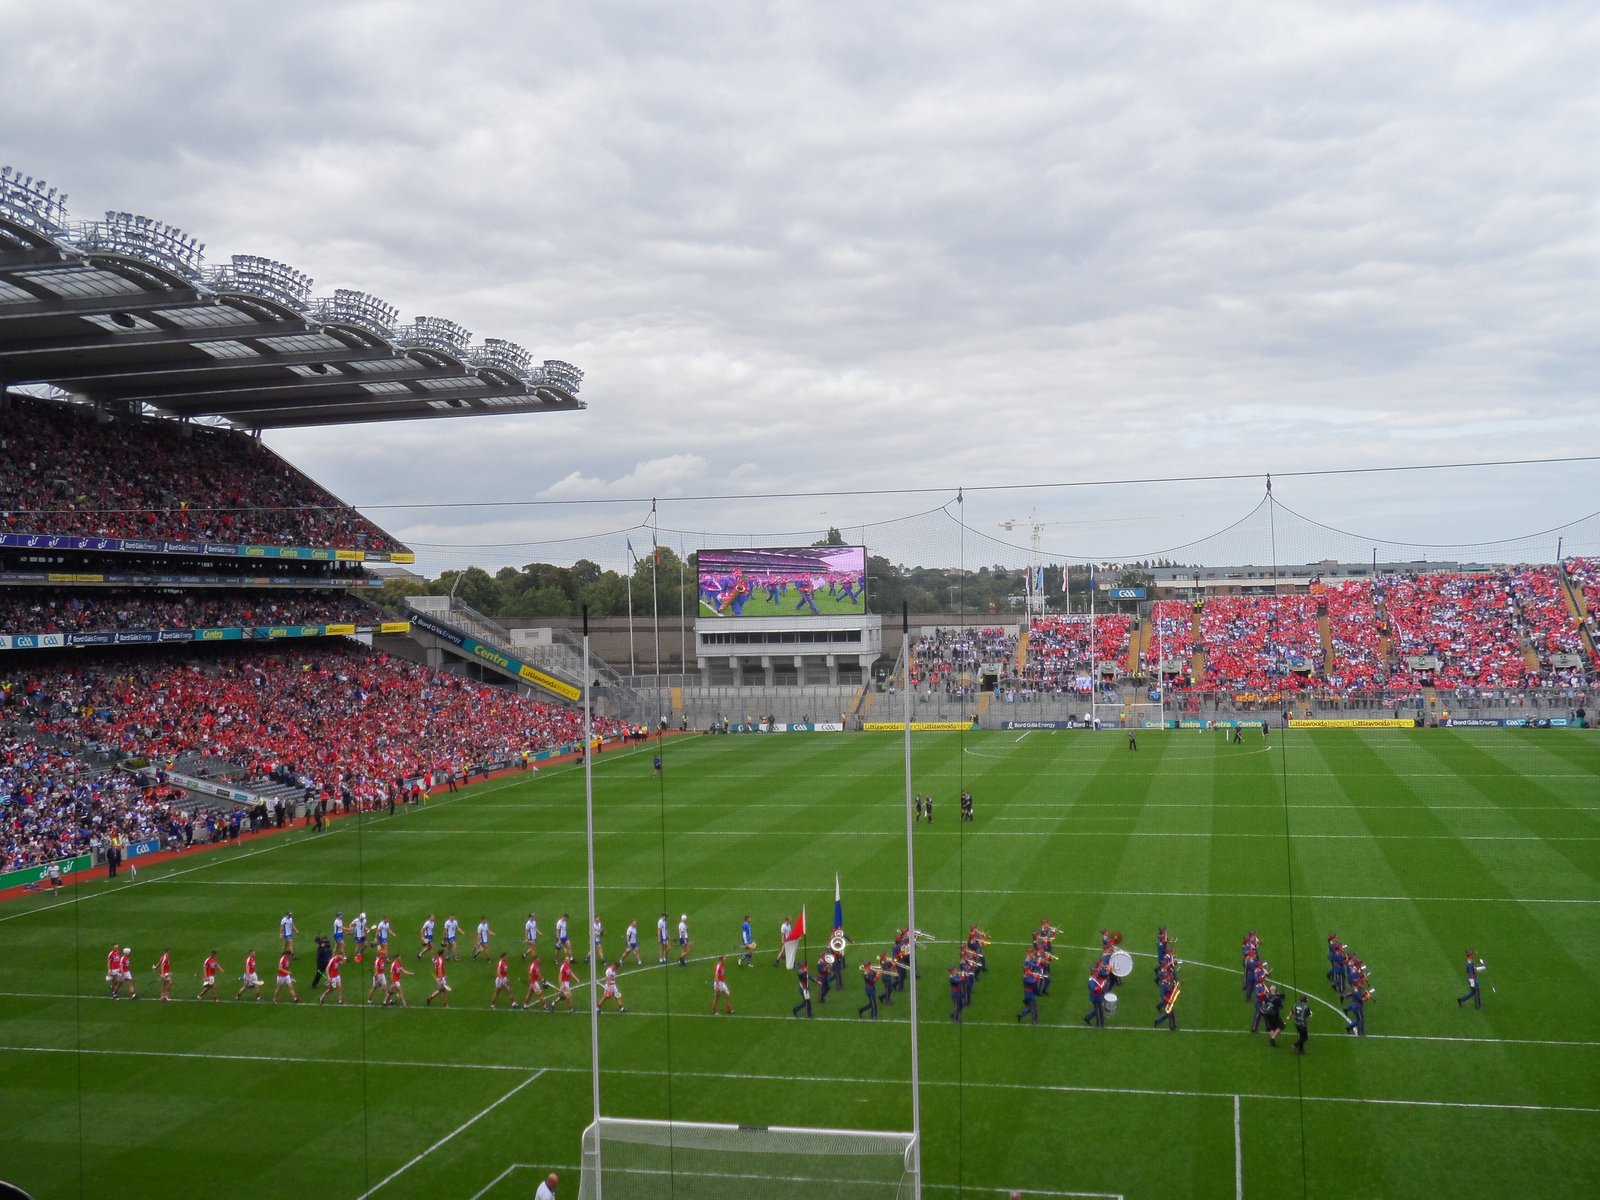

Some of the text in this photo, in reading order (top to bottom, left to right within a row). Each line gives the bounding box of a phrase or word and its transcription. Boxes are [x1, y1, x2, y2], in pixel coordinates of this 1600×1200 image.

[246, 546, 264, 556] Centra
[280, 548, 298, 558] Centra
[312, 549, 328, 558] Centra
[1118, 590, 1136, 598] GAA
[202, 630, 224, 640] Centra
[269, 628, 287, 637] Centra
[418, 619, 431, 629] Bord
[442, 630, 462, 644] Energy
[18, 636, 34, 647] GAA
[44, 636, 58, 646] GAA
[474, 646, 508, 667] Centra
[522, 668, 556, 689] Littlewoods
[136, 843, 150, 854] GAA
[63, 861, 74, 873] eir
